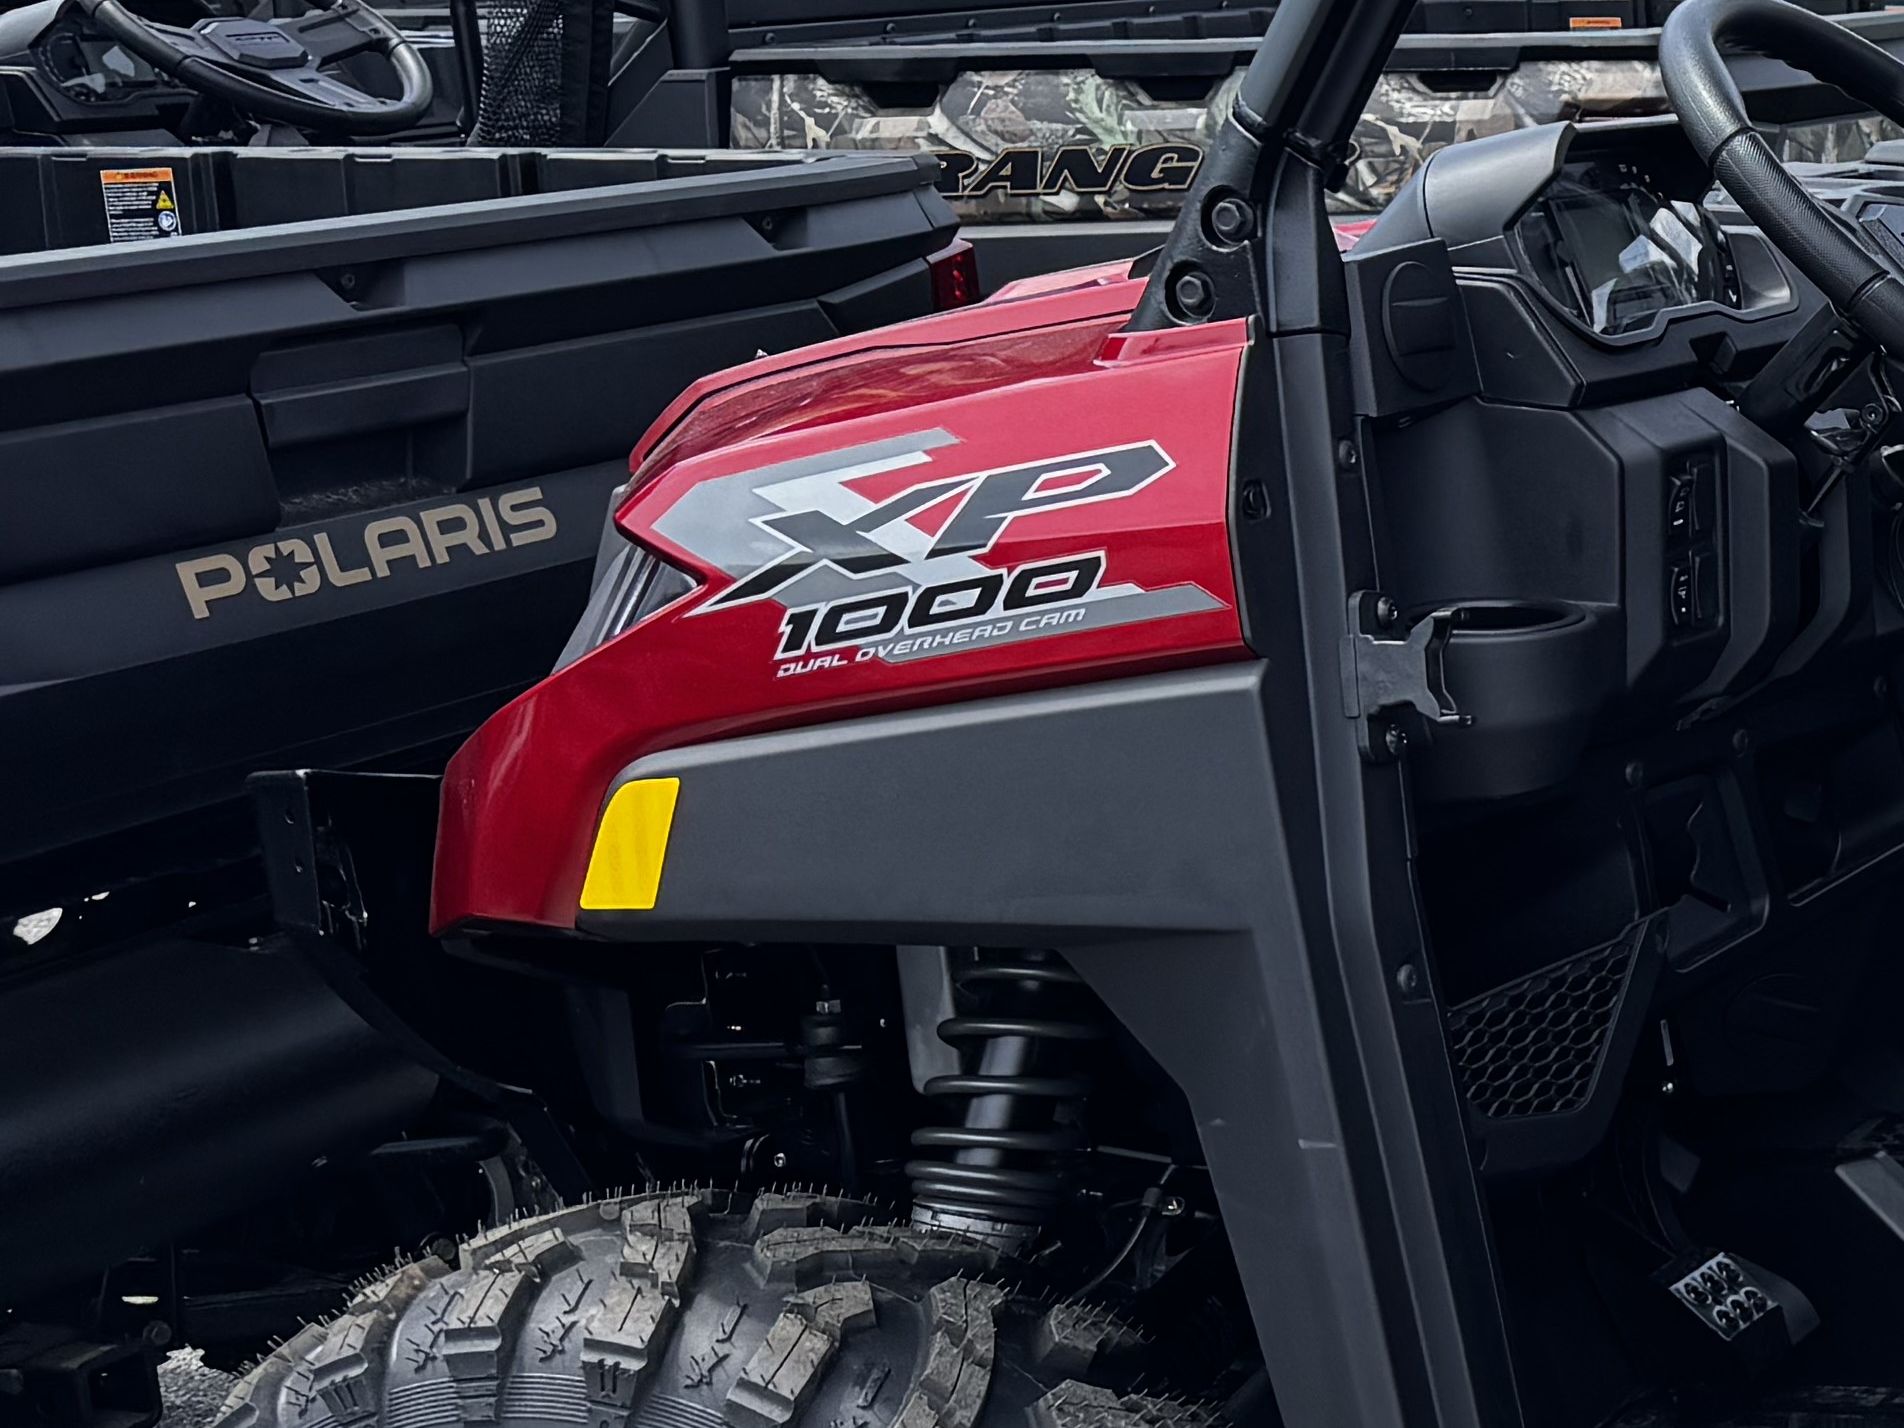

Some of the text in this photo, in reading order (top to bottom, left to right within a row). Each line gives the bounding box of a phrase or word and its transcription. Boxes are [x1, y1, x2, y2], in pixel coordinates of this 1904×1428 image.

[932, 143, 1204, 196] RANG
[175, 486, 558, 620] POLARIS
[684, 438, 1177, 618] XP
[772, 547, 1108, 662] 1000
[776, 607, 1087, 679] DUAL OVERHEAD CAM
